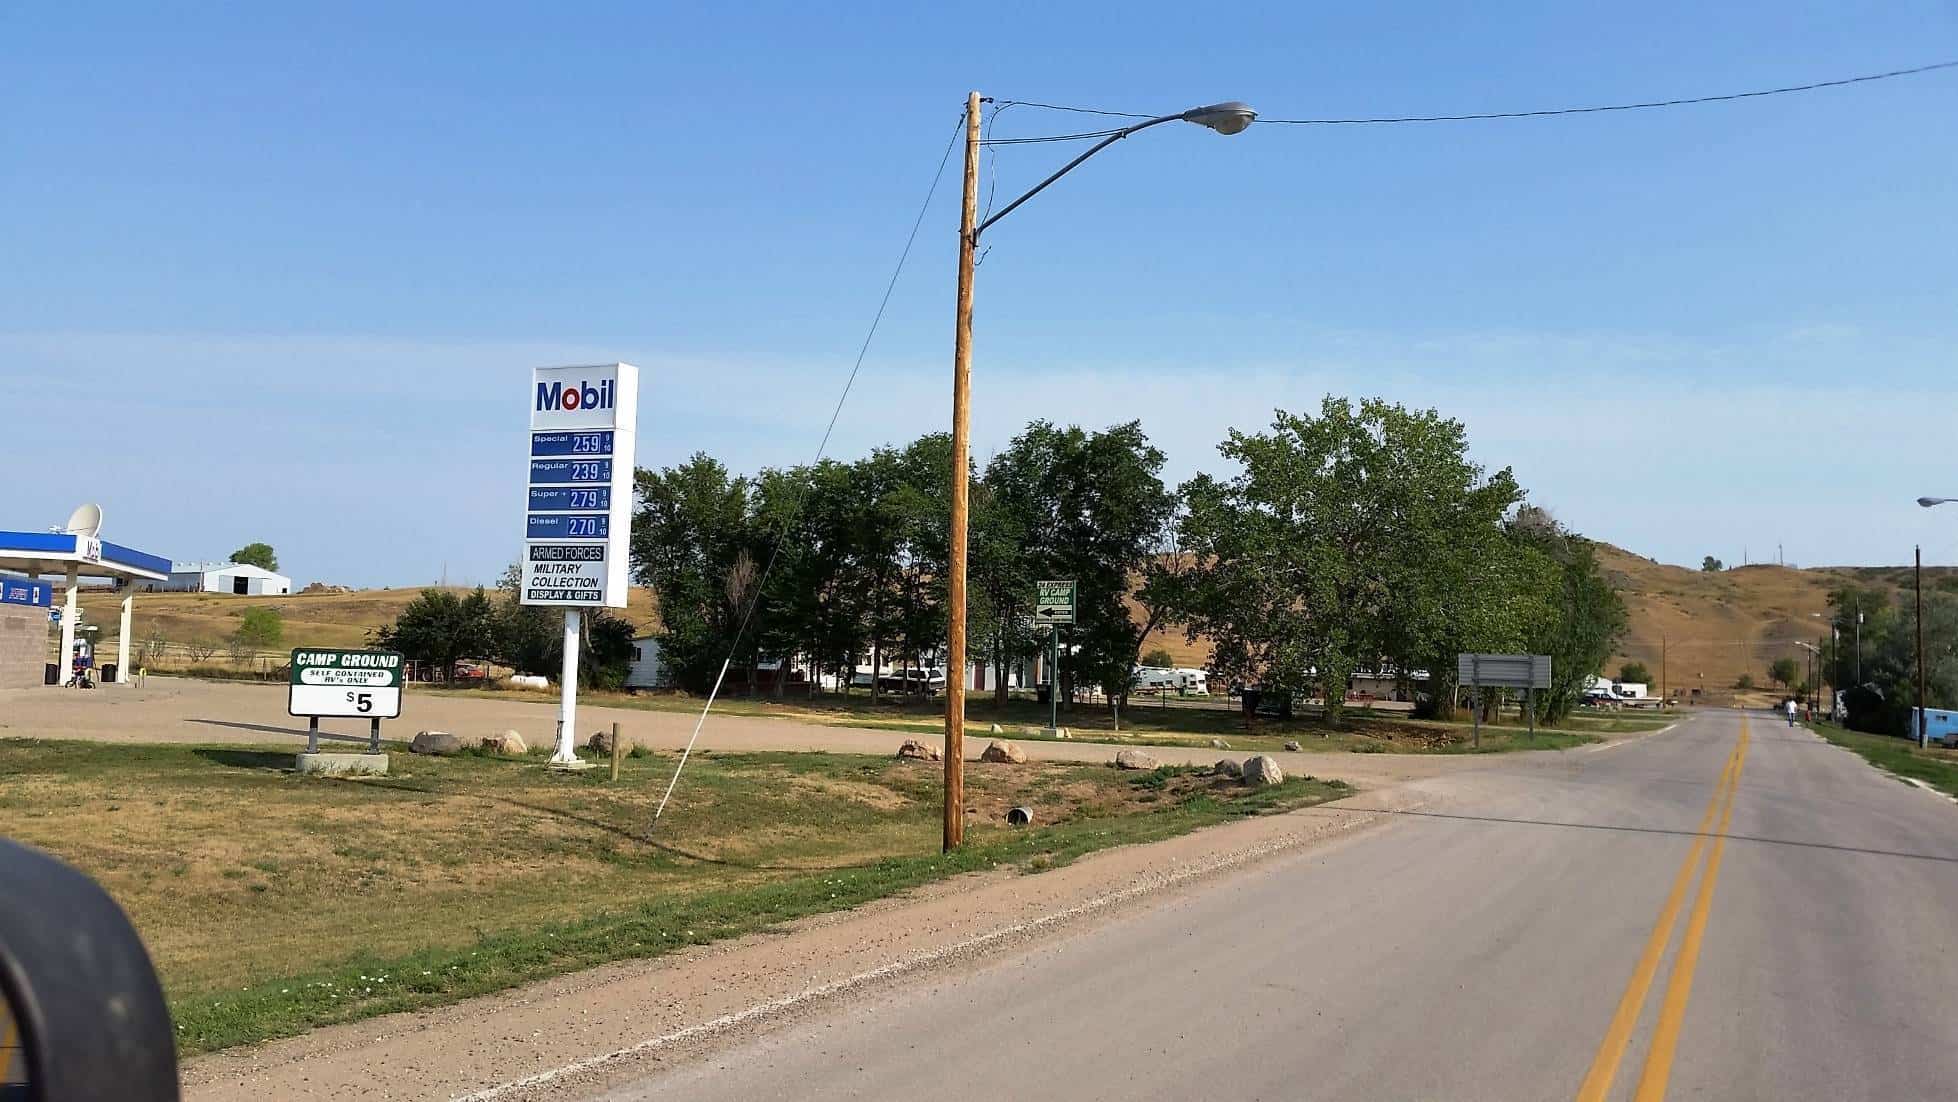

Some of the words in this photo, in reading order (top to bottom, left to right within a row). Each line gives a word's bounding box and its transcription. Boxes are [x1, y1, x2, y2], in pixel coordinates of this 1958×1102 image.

[536, 379, 614, 411] Mobil
[534, 435, 568, 443] Special
[531, 462, 569, 471] Regular
[530, 490, 559, 499] Super
[529, 517, 559, 525] Diesel
[532, 547, 564, 559] ARMED
[565, 547, 601, 560] FORCES
[534, 564, 582, 574] MILITARY
[531, 577, 599, 588] COLLECTION
[530, 590, 564, 599] DISPLAY
[566, 591, 572, 599] &
[574, 591, 599, 600] GIFTS
[1040, 588, 1050, 596] RV
[1050, 588, 1070, 596] CAMP
[1040, 596, 1070, 605] GROUND
[296, 652, 337, 666] CAMP
[341, 654, 399, 668] GROUND
